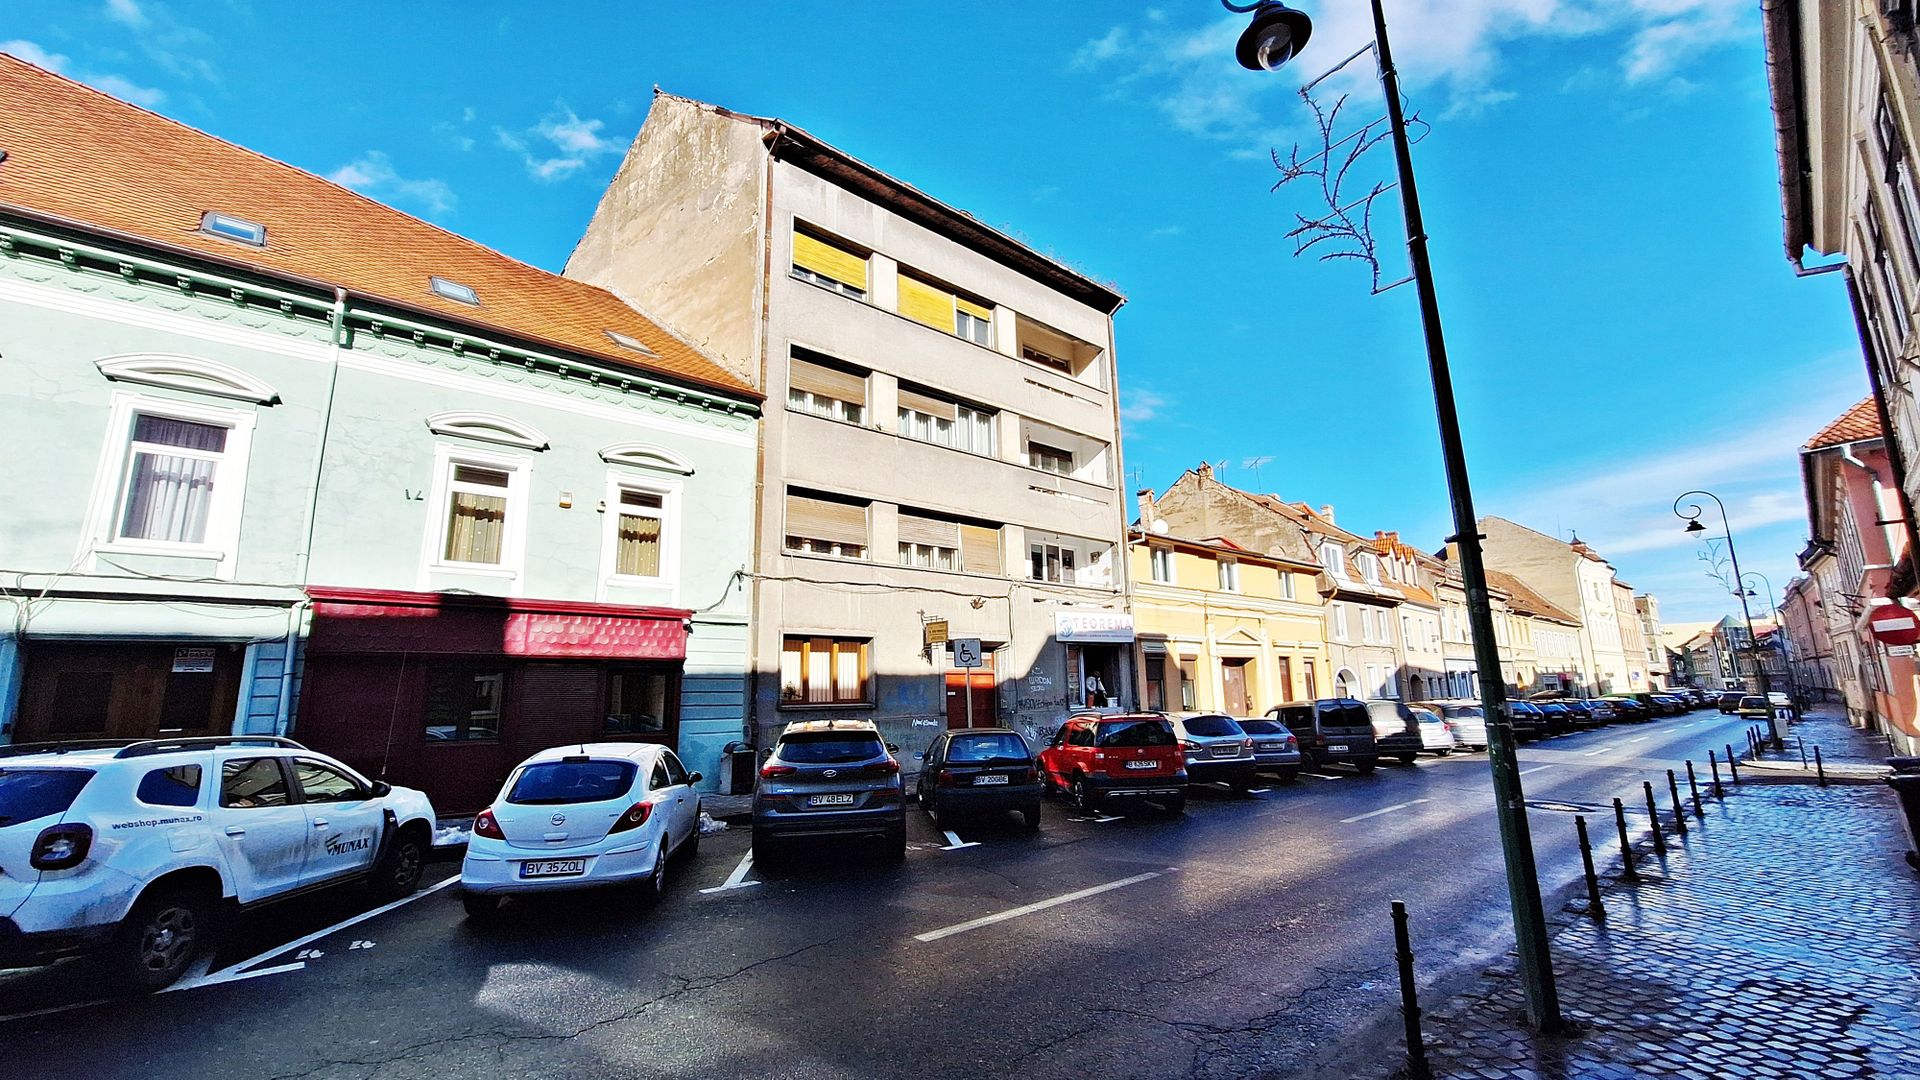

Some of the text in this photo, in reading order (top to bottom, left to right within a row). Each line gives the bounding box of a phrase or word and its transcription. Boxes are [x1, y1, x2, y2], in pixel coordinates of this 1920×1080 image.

[1072, 616, 1134, 631] TEOREMA
[811, 796, 823, 804] BV
[112, 815, 202, 829] webshop.munax.ro
[331, 837, 370, 856] MUNAX
[526, 863, 543, 874] BV
